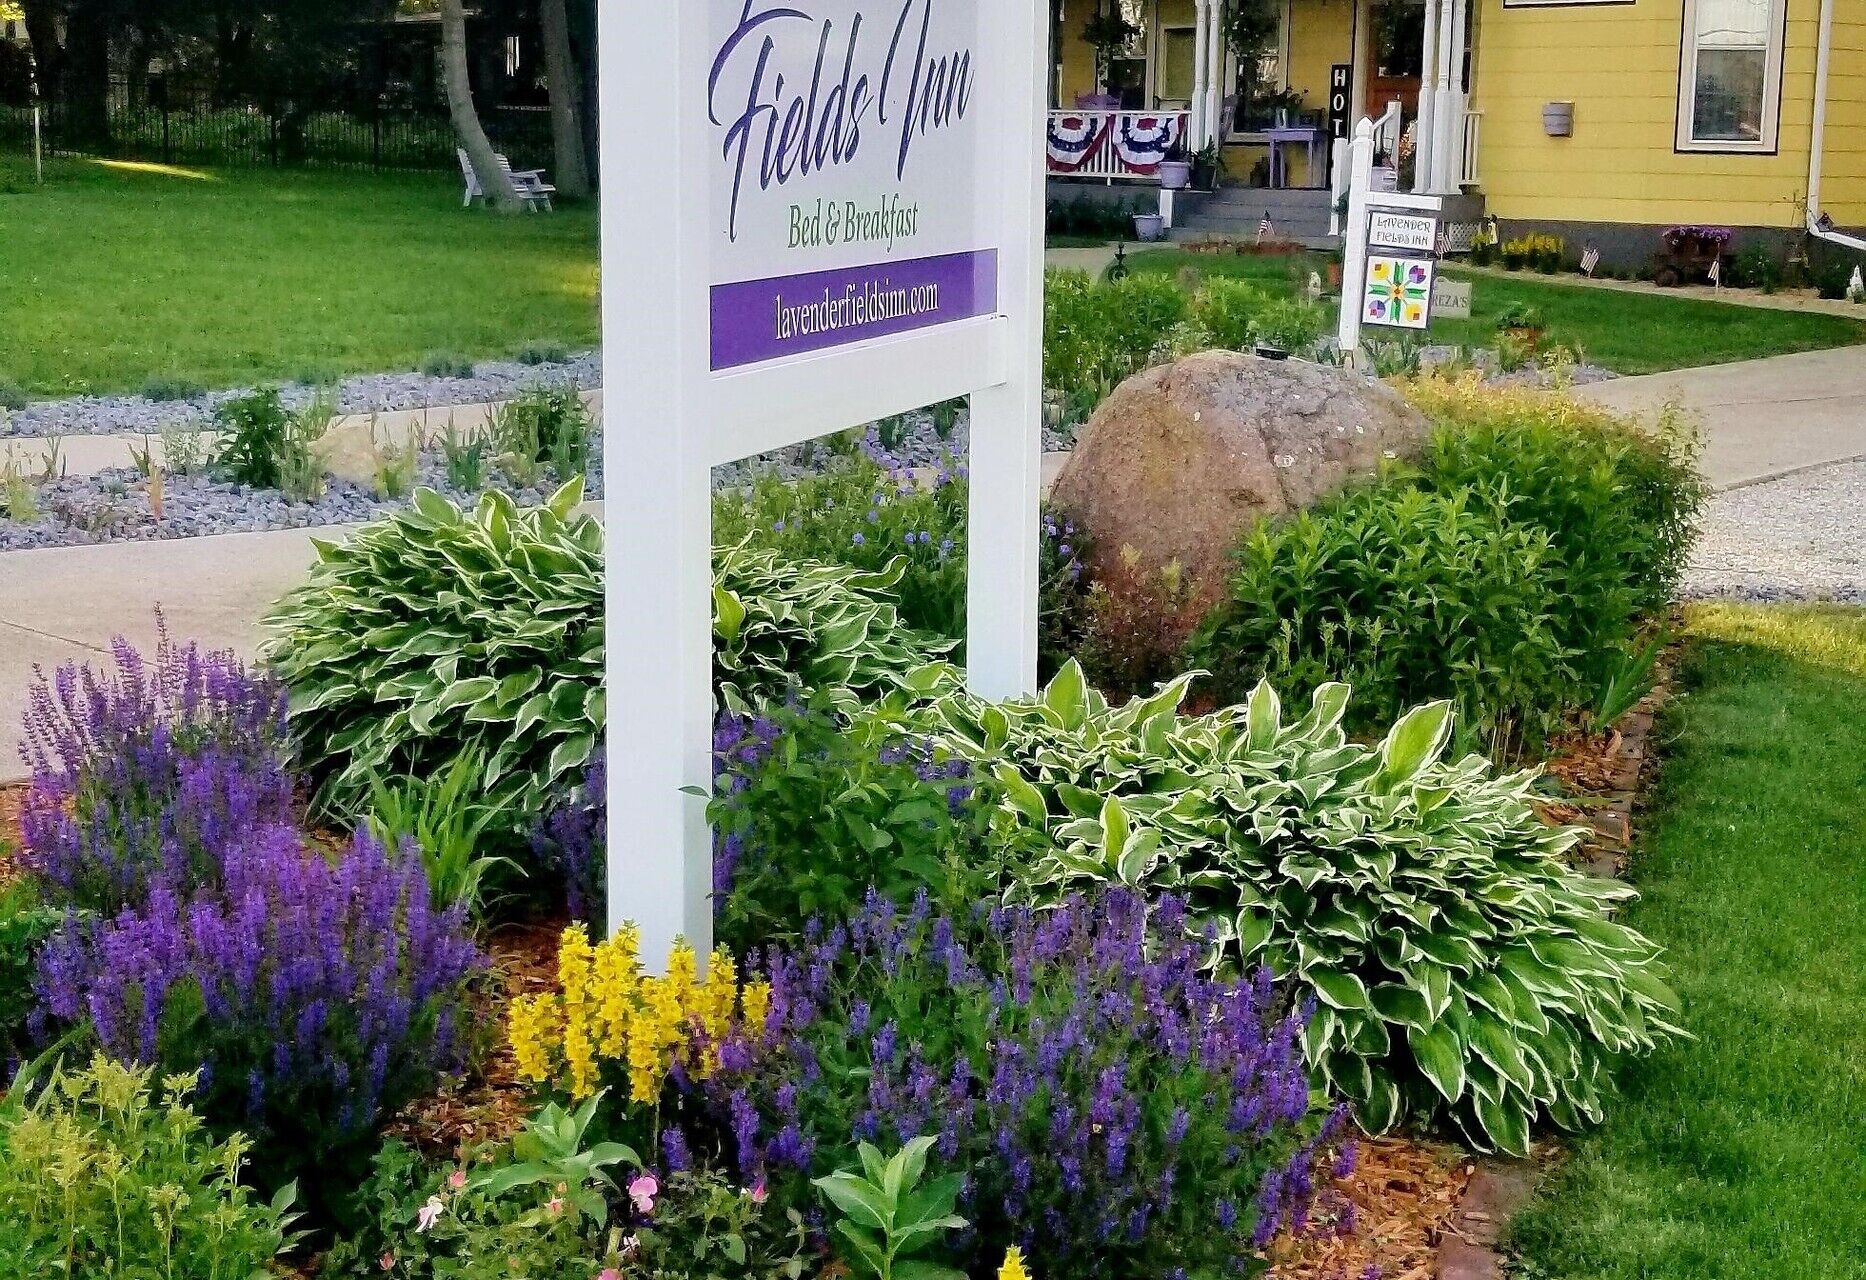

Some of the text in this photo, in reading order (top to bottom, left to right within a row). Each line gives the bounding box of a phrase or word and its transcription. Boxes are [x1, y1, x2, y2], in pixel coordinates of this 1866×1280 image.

[708, 7, 874, 243] Fields
[787, 192, 918, 253] Bed & Breakfast
[1376, 231, 1429, 246] FIELDS INN
[774, 277, 939, 340] lavenderfieldsinn.com
